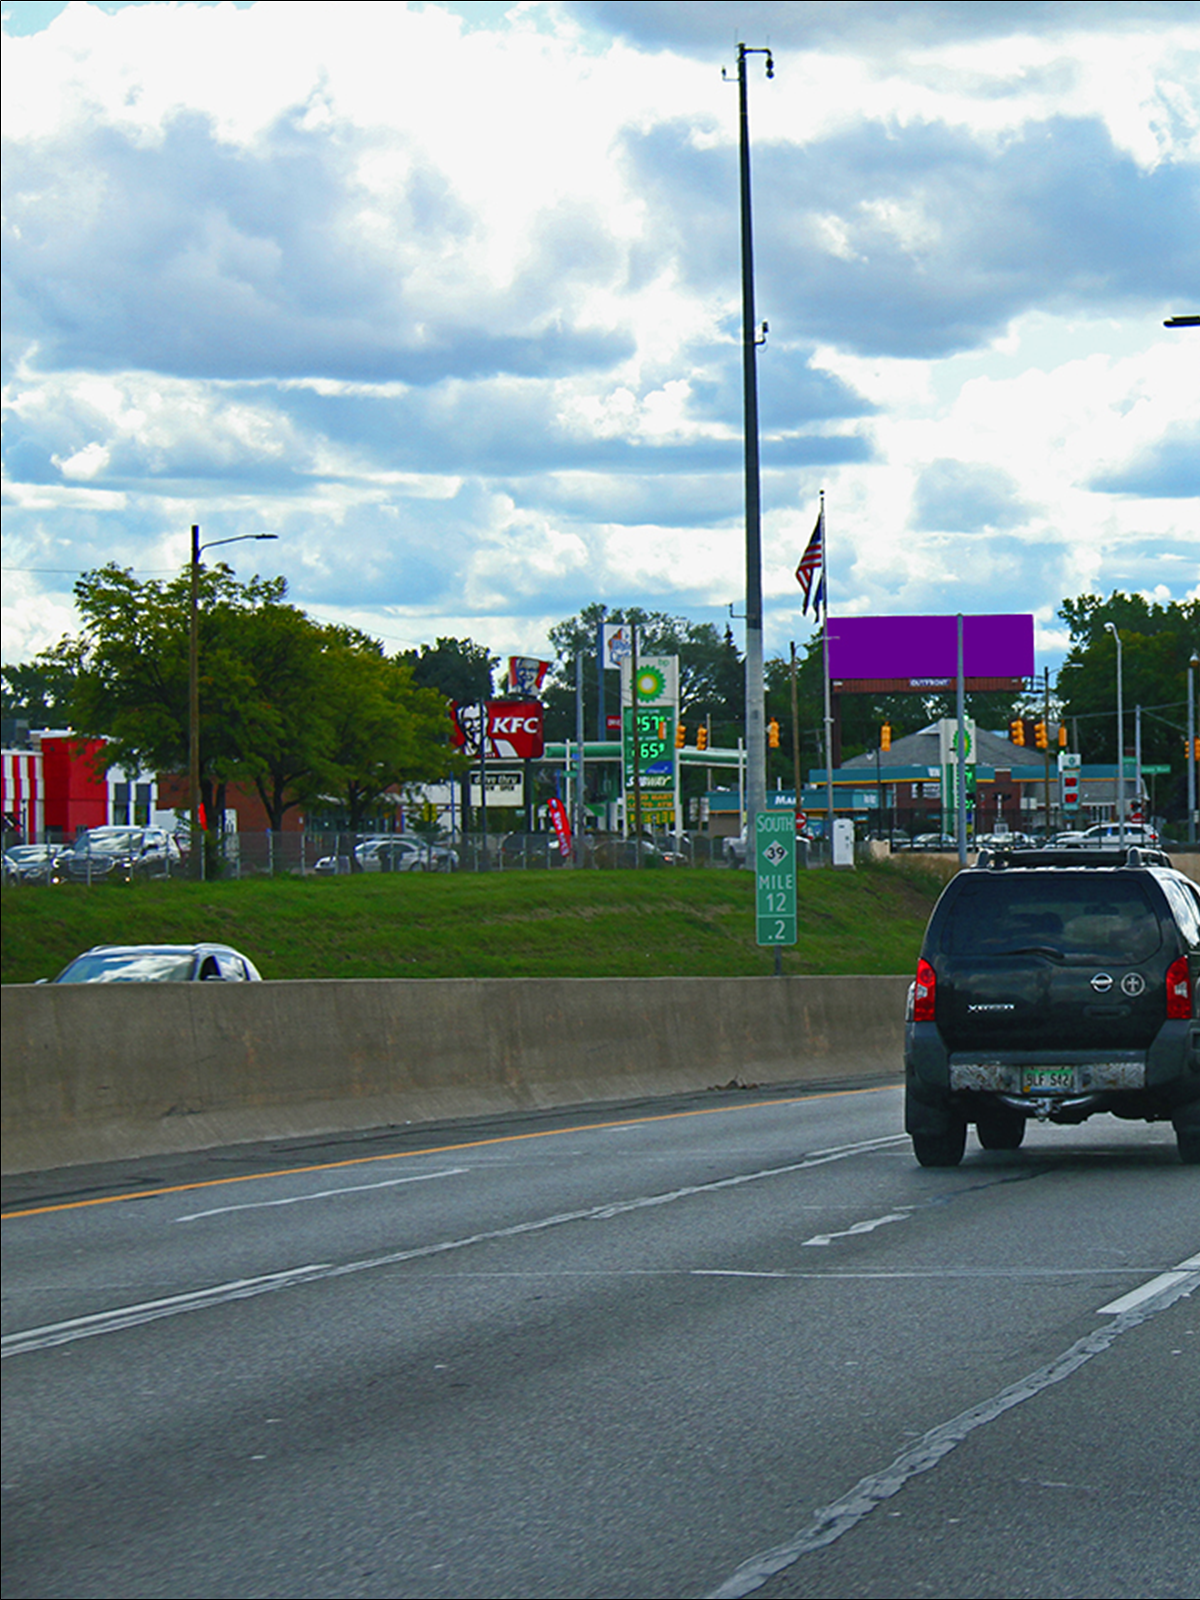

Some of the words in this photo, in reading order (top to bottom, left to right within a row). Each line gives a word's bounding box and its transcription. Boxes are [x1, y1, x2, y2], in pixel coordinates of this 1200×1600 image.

[492, 716, 539, 733] KFC
[757, 815, 794, 833] SOUTH
[766, 847, 785, 860] 39
[759, 874, 793, 890] MILE
[766, 892, 787, 912] 12
[768, 920, 786, 940] .2
